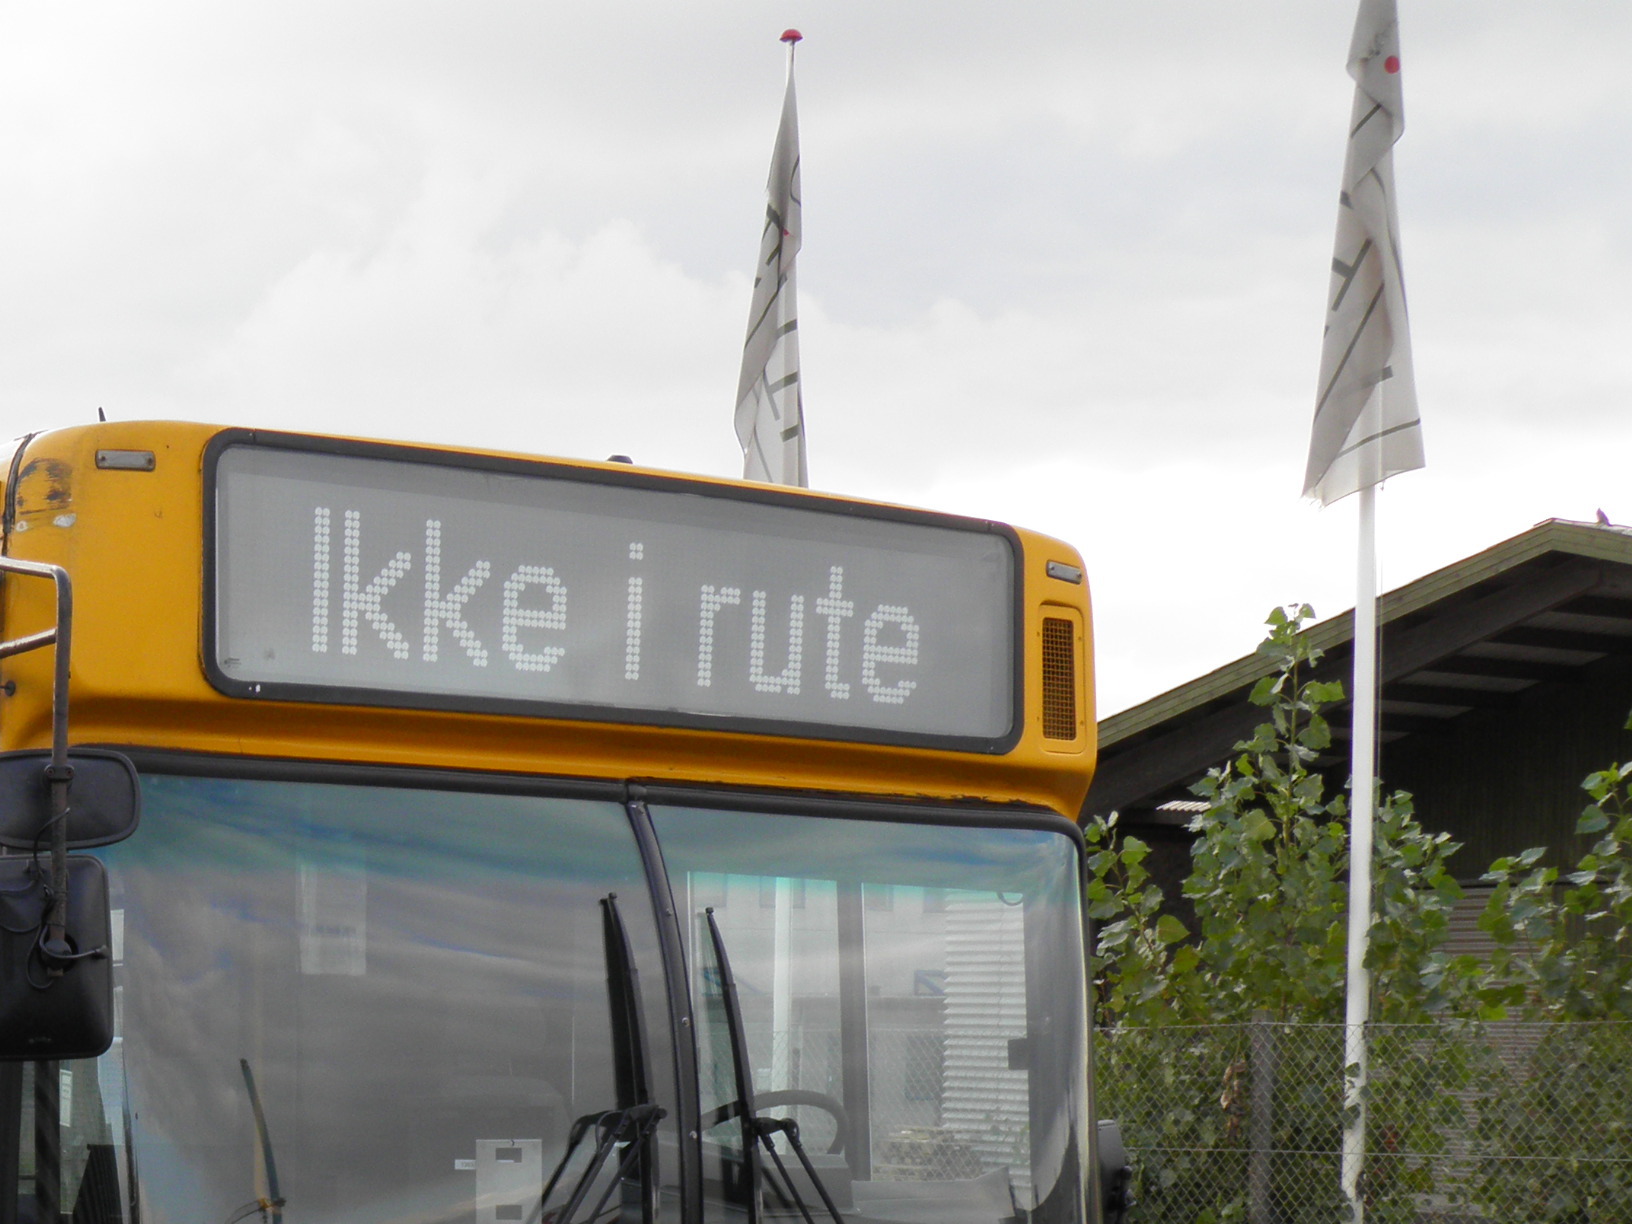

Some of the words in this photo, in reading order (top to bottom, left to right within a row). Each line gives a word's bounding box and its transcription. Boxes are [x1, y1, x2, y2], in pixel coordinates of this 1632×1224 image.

[311, 506, 567, 673] Ikke
[624, 542, 644, 682] i
[696, 565, 921, 705] rute
